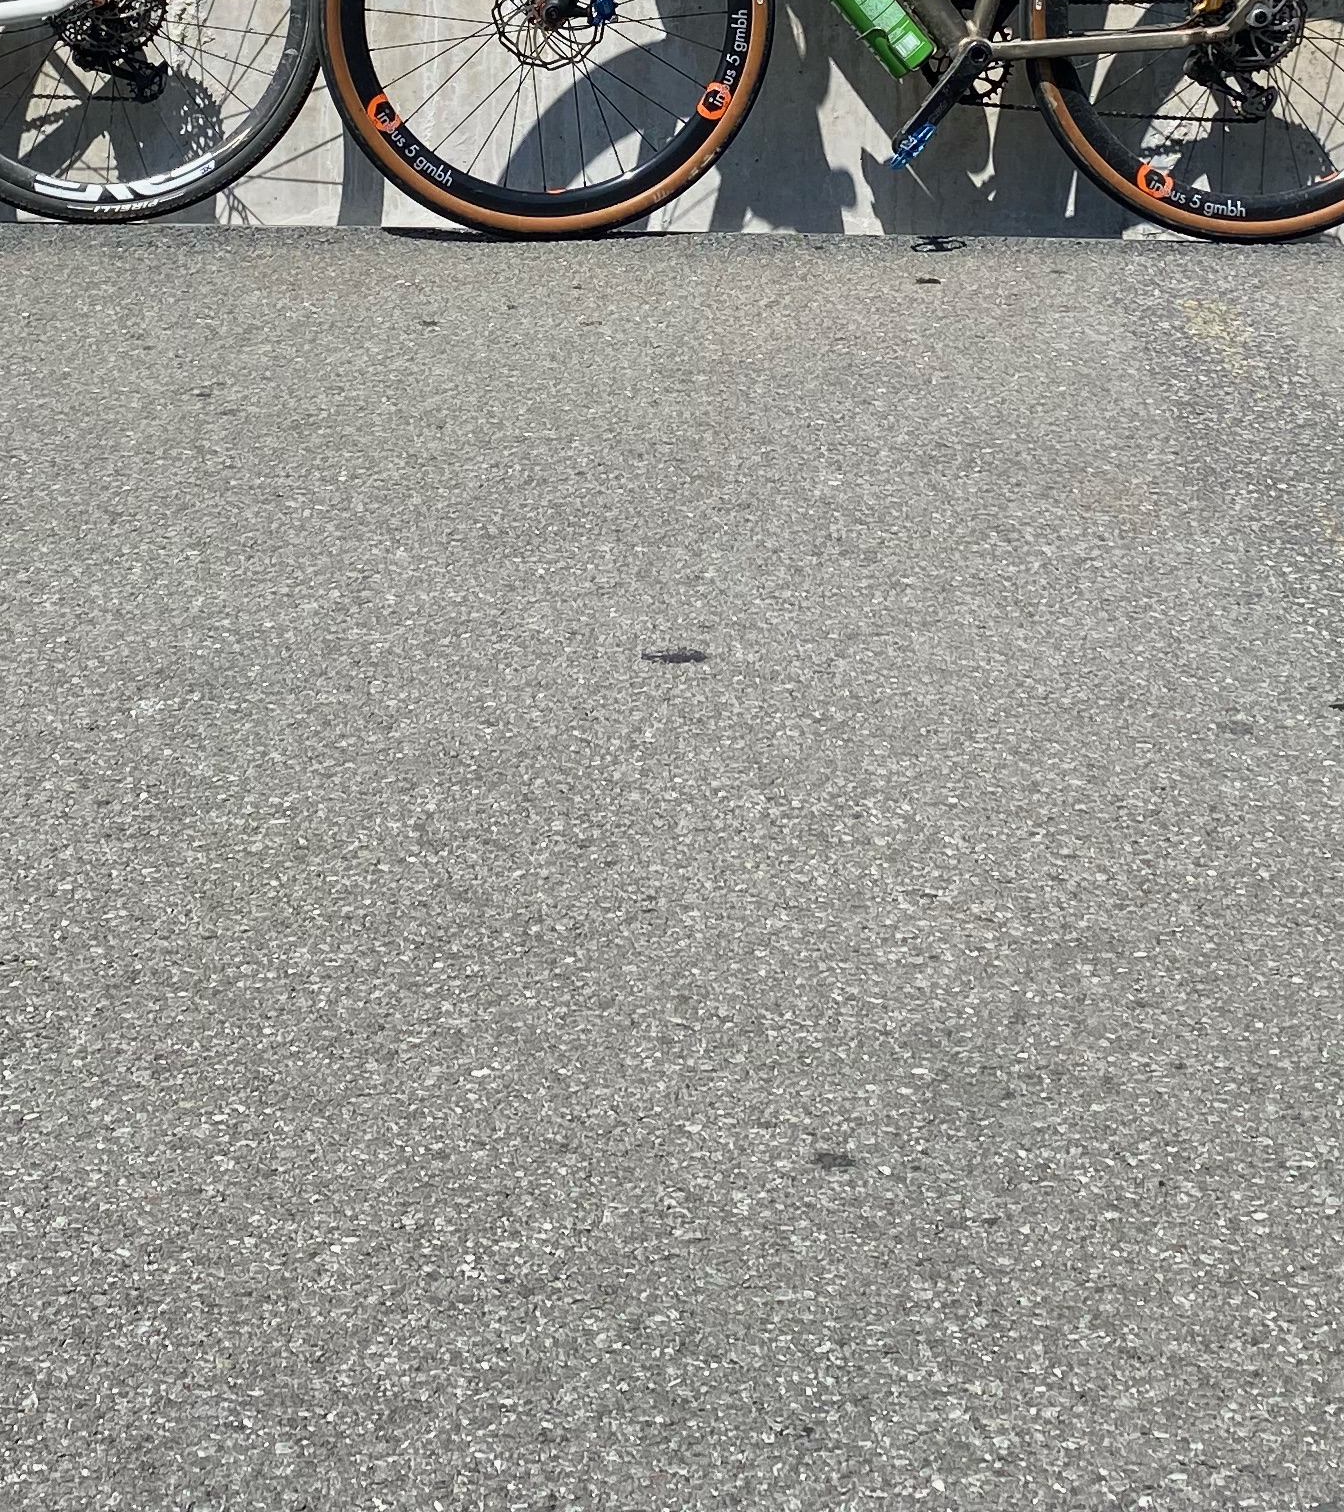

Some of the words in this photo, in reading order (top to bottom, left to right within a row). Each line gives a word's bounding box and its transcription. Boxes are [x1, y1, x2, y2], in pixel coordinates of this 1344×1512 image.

[730, 9, 748, 52] gmbh
[413, 156, 453, 187] gmbh
[93, 198, 158, 213] PIRELLI
[1203, 199, 1246, 218] gmbh
